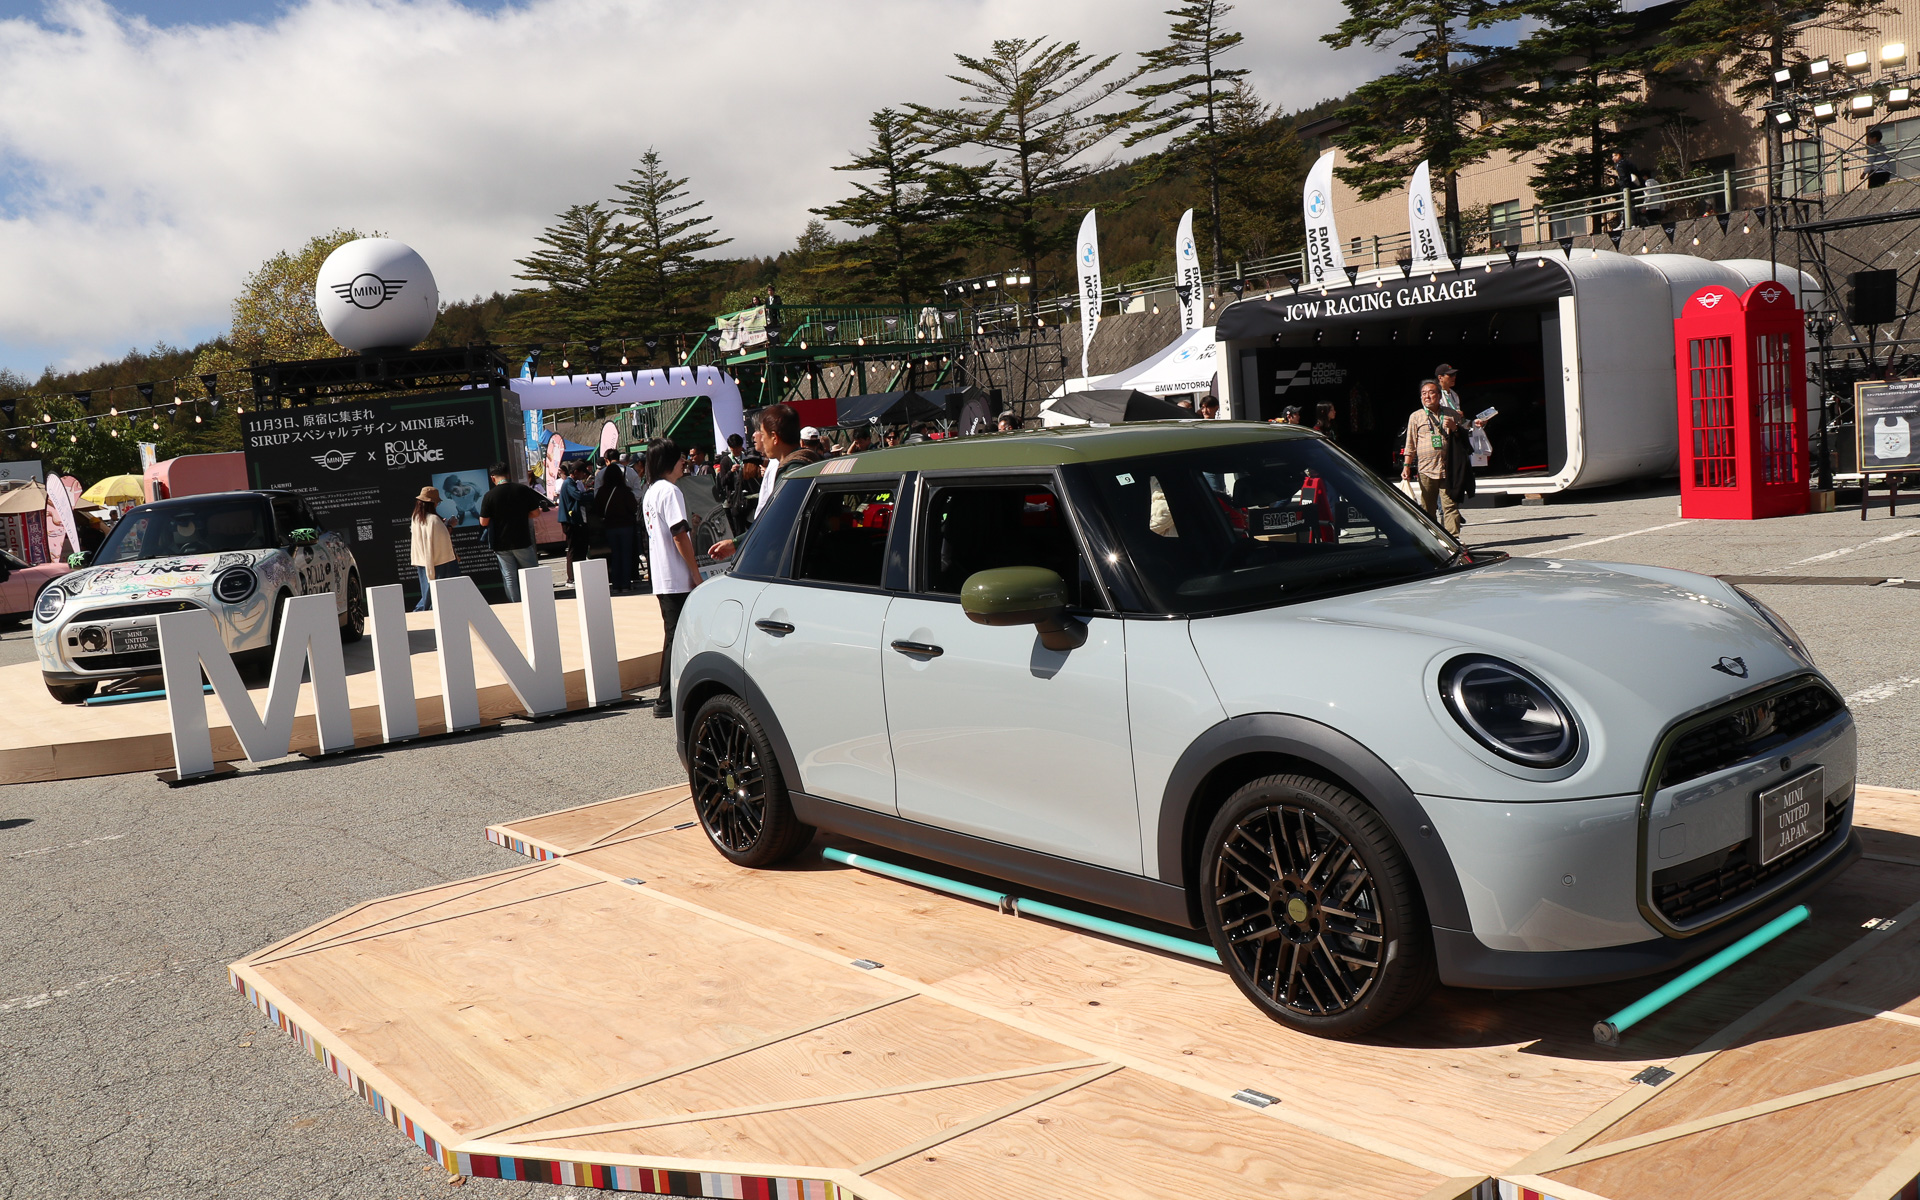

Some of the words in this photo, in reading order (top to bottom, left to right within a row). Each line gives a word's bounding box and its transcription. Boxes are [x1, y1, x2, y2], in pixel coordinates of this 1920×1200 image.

[1318, 226, 1334, 268] BMW
[354, 285, 382, 297] MINI
[1192, 267, 1201, 301] BMW
[1283, 301, 1321, 322] JCW
[1325, 291, 1393, 317] RACING
[1396, 278, 1478, 306] GARAGE
[1311, 369, 1347, 378] COOPER
[1312, 362, 1336, 370] JOHN
[1155, 382, 1174, 392] BMW
[1311, 376, 1343, 385] WORKS
[249, 408, 375, 433] 11月3日、原宿に集まれ
[384, 438, 428, 453] ROLL&
[326, 456, 343, 464] MINI
[386, 449, 445, 466] BOUNCE
[124, 636, 149, 645] UNITED
[127, 631, 143, 639] MINI
[126, 642, 149, 650] JAPAN.
[156, 558, 622, 776] MINI
[1783, 786, 1804, 809] MINI
[1778, 802, 1810, 829] UNITED
[1779, 820, 1809, 848] JAPAN.
